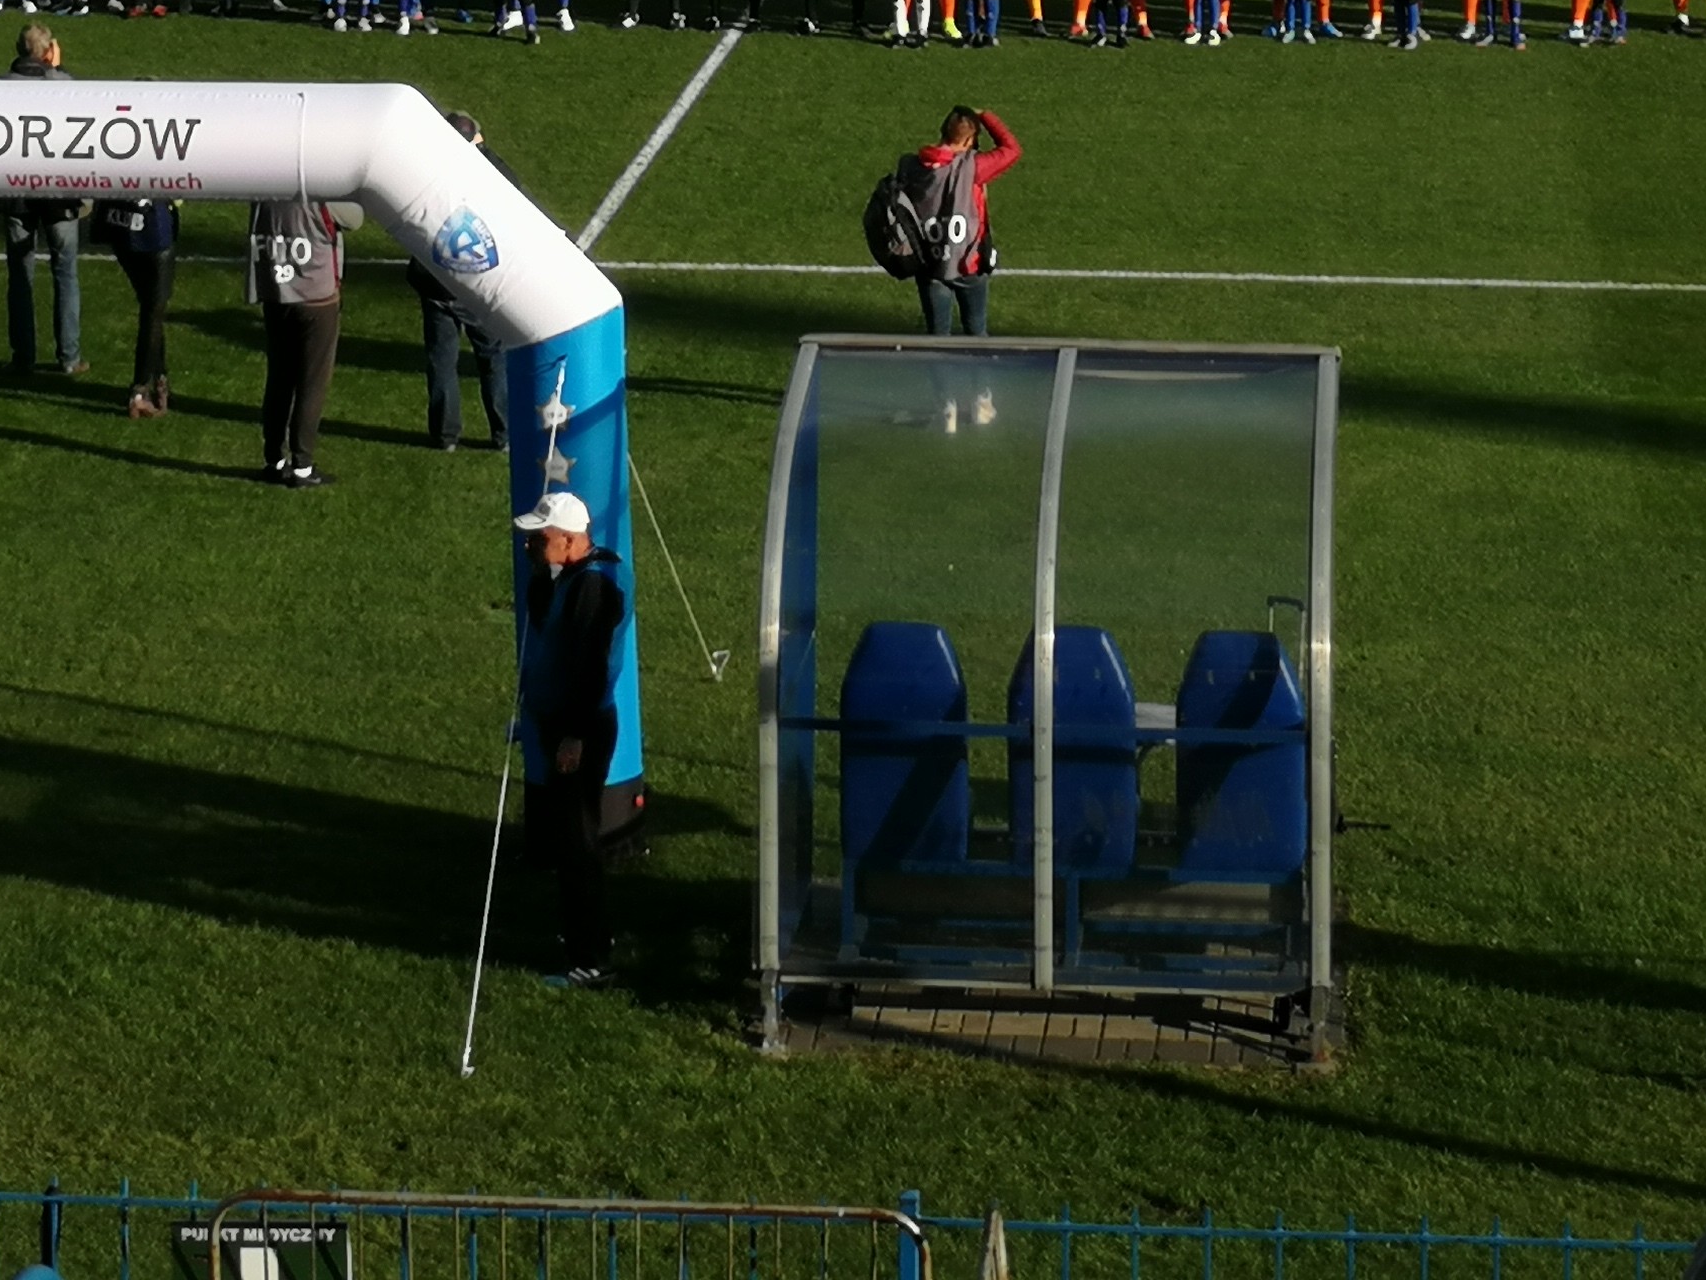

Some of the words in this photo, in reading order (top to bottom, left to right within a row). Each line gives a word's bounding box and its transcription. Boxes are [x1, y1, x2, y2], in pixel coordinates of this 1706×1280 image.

[6, 172, 113, 191] wprawia
[120, 175, 141, 190] w
[149, 172, 203, 191] ruch
[180, 1226, 240, 1242] PUKT
